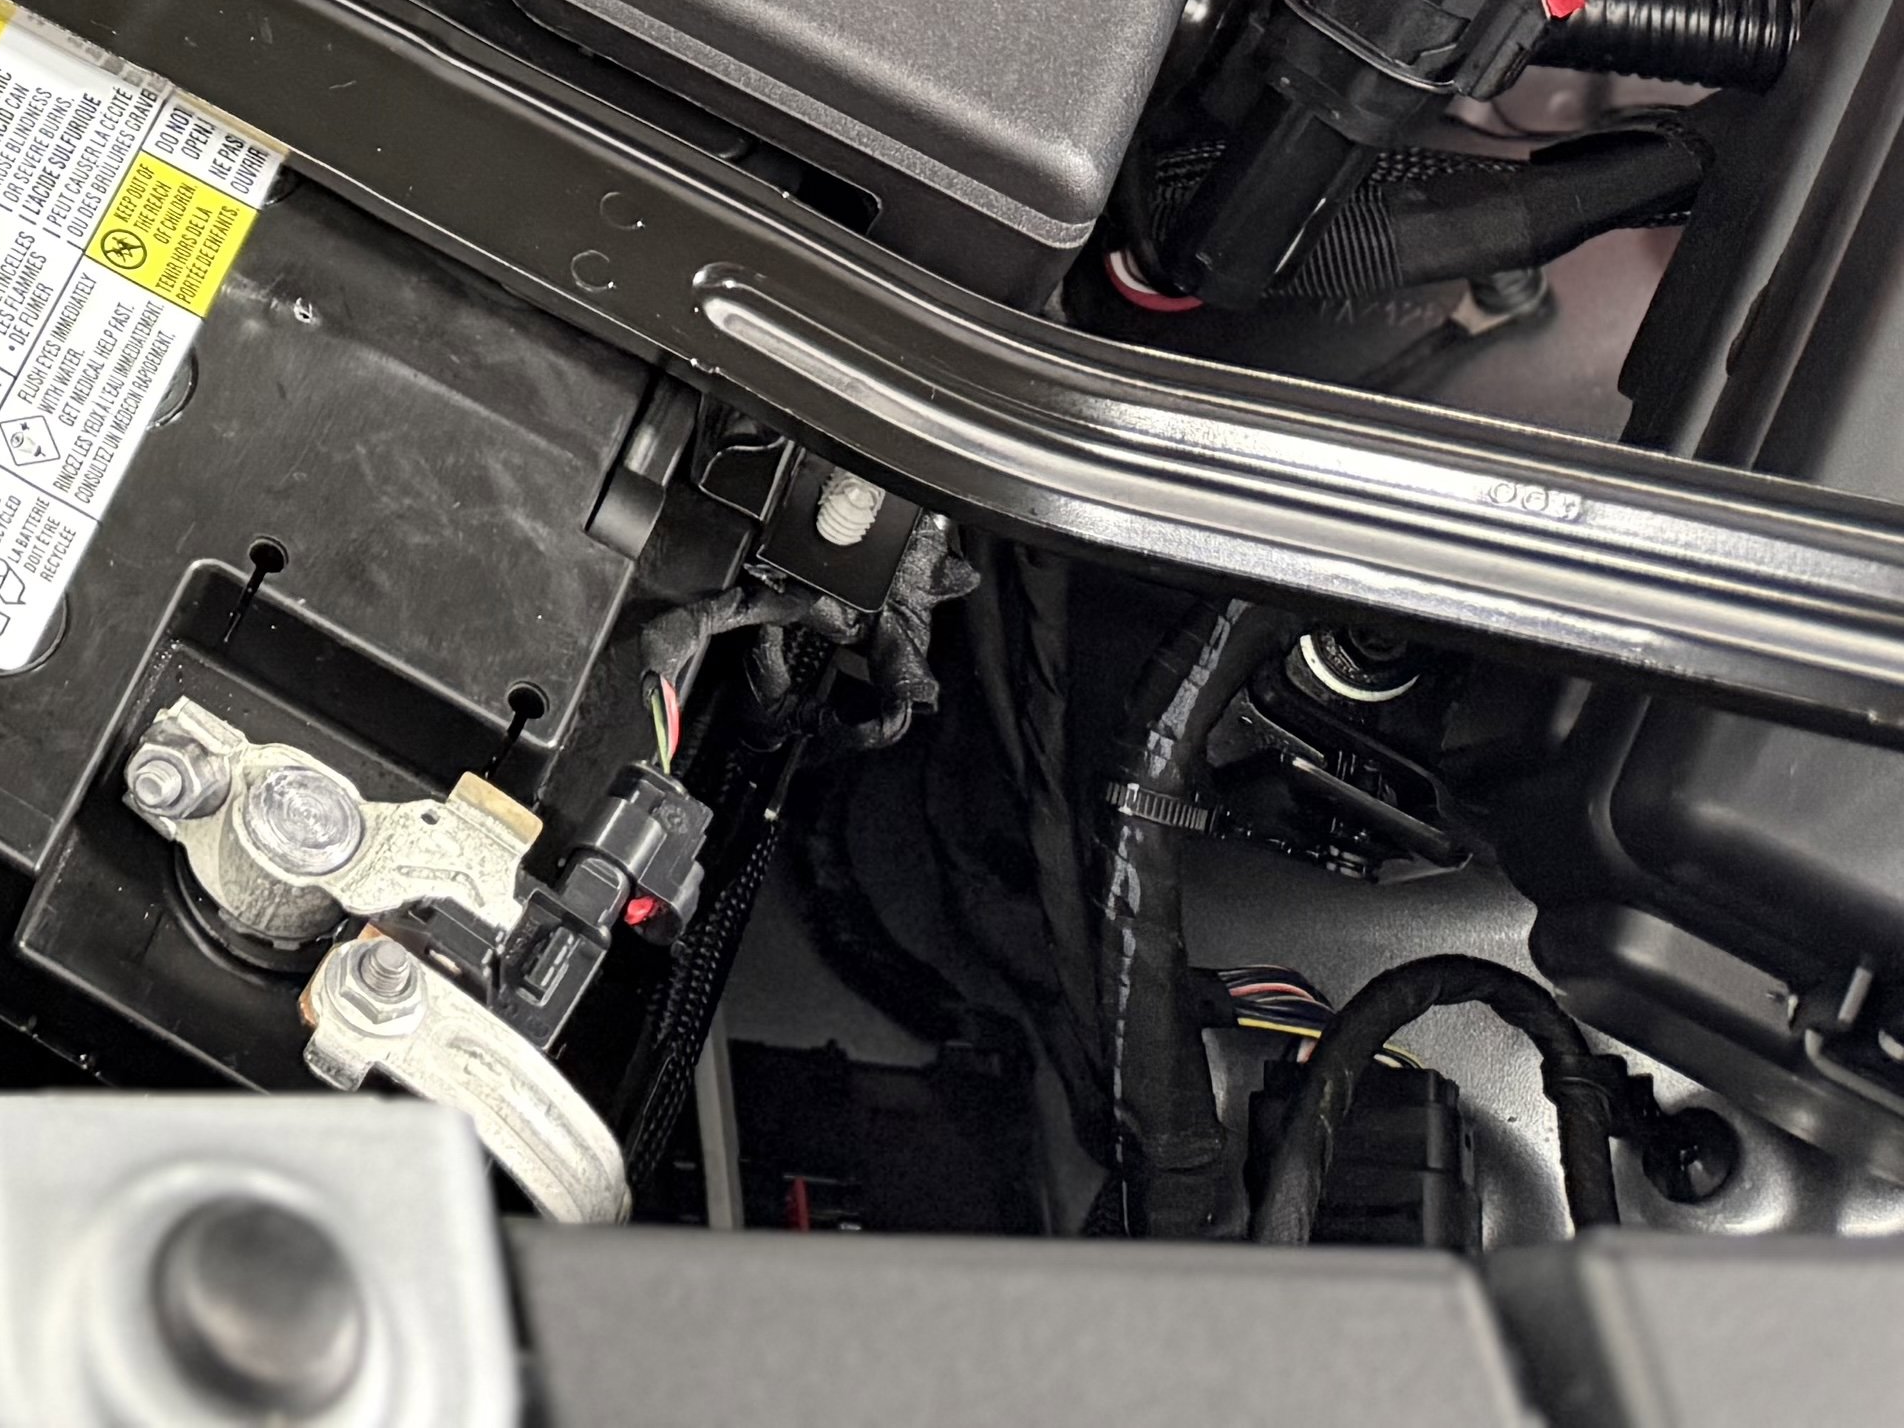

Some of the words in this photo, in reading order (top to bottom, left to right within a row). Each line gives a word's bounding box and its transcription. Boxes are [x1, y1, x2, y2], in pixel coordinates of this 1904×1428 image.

[4, 82, 30, 110] CAN
[4, 87, 52, 154] BLINDNESS
[38, 96, 75, 140] BURNS.
[22, 166, 61, 216] L'ACIDE
[48, 93, 102, 170] SULFURIQUE
[154, 131, 180, 155] DO
[217, 134, 245, 163] PAS
[13, 136, 50, 185] SEVERE
[136, 163, 155, 180] OF
[208, 158, 233, 181] NE
[2, 182, 25, 203] OR
[46, 192, 75, 228] PEUT
[64, 145, 102, 195] CAUSER
[89, 129, 111, 148] LA
[125, 176, 149, 200] OUT
[76, 191, 102, 219] DES
[113, 195, 137, 223] KEEP
[143, 180, 172, 216] REACH
[66, 216, 89, 238] OU
[133, 211, 156, 233] THE
[185, 219, 206, 238] DE
[192, 206, 213, 223] LA
[152, 227, 172, 245] OF
[170, 233, 198, 265] HORS
[195, 248, 216, 268] DE
[3, 251, 47, 312] FLAMMES
[155, 261, 183, 293] TENIR
[18, 282, 54, 328] FUMER
[8, 324, 31, 346] DE
[17, 366, 48, 405] FLUSH
[35, 339, 62, 370] EYES
[50, 272, 97, 343] IMMEDIATELY
[93, 329, 118, 360] HELP
[37, 383, 65, 415] WITH
[52, 348, 85, 386] WATER.
[69, 358, 105, 406] MEDICAL
[58, 401, 81, 427] GET
[81, 409, 107, 438] YEUX
[71, 435, 94, 458] LES
[52, 453, 84, 493] RINCEZ
[74, 446, 115, 504] CONSULTEZ
[102, 431, 123, 450] UN
[15, 497, 50, 549] BATTERIE
[7, 547, 25, 564] LA
[23, 544, 46, 574] DOIT
